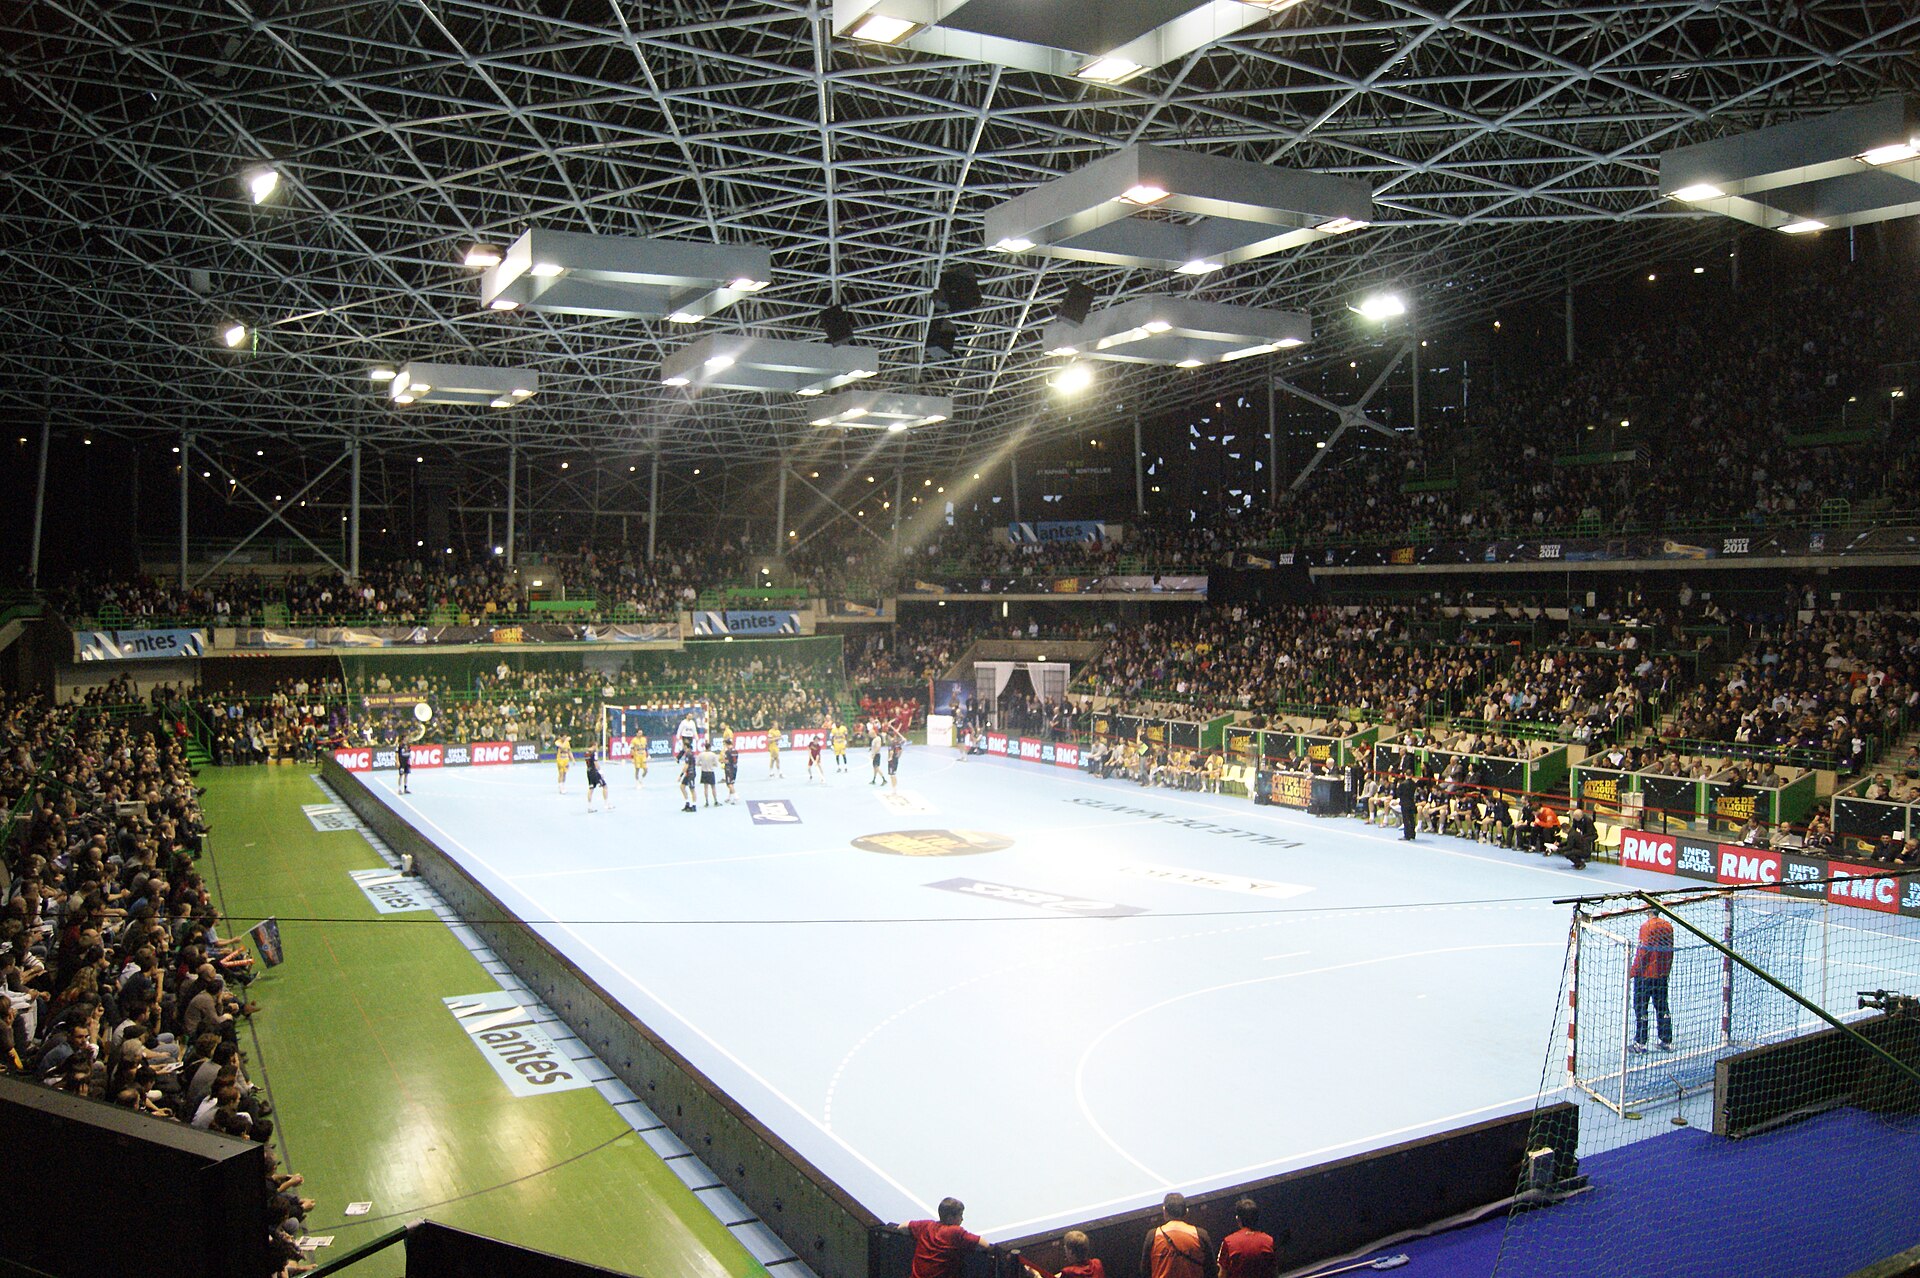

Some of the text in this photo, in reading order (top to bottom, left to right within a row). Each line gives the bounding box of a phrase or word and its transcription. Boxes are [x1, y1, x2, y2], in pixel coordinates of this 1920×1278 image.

[1539, 549, 1560, 558] 2011
[1723, 543, 1748, 553] 2011
[735, 735, 768, 750] RMC
[988, 737, 1007, 752] RMC
[474, 746, 511, 762] RMC
[1021, 742, 1040, 758] RMC
[1056, 747, 1077, 764] RMC
[1272, 774, 1312, 788] COUPE DE
[1584, 779, 1617, 787] COUPE DE
[1272, 782, 1312, 798] LA LIGUE
[1593, 786, 1617, 795] LIGUE
[1717, 796, 1755, 804] COUPE DE
[1726, 803, 1755, 812] LIGUE
[1164, 819, 1219, 831] DE
[1208, 828, 1305, 849] VILLE
[1624, 837, 1673, 866] RMC
[1683, 847, 1710, 857] INFO
[1677, 860, 1716, 874] SPORT
[1683, 855, 1710, 866] TALK
[1721, 853, 1777, 882] RMC
[1789, 863, 1819, 875] INFO
[1831, 870, 1895, 904] RMC
[466, 1005, 573, 1086] Nantes
